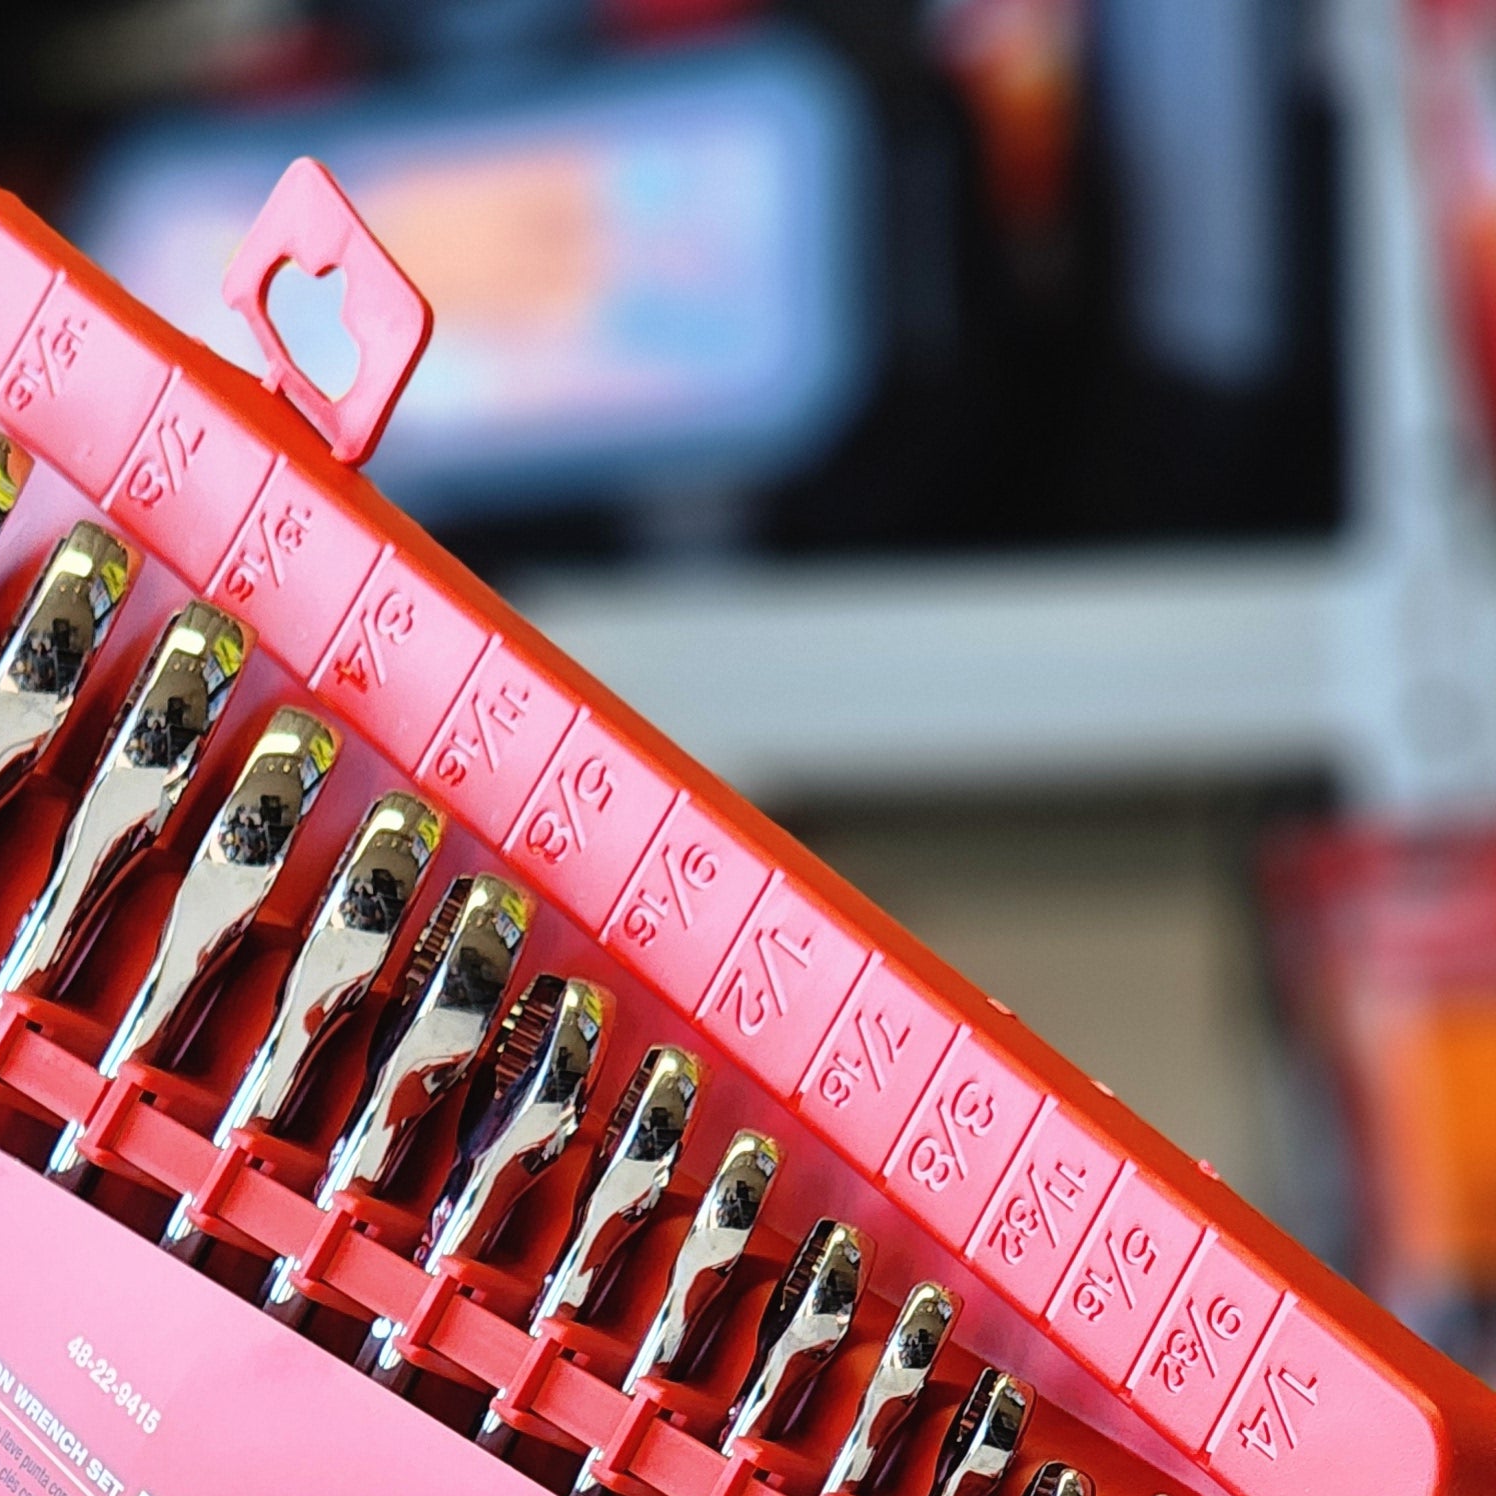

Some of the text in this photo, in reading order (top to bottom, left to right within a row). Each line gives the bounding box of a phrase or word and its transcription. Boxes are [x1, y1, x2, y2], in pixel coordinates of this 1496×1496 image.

[129, 414, 205, 509] 7/8
[332, 591, 415, 693] 3/4
[437, 680, 530, 786] 11/16
[524, 755, 617, 864] 5/8
[621, 840, 722, 949] 9/16
[715, 920, 814, 1037] 1/2
[817, 1009, 912, 1110] 7/16
[908, 1079, 996, 1195] 3/8
[988, 1157, 1087, 1267] 11/32
[1071, 1225, 1161, 1324] 5/16
[66, 1335, 162, 1435] 48-22-9415
[1150, 1293, 1245, 1395] 9/32
[0, 1429, 24, 1461] llave
[19, 1454, 50, 1489] punta
[13, 1383, 89, 1467] WRENCH
[1236, 1364, 1321, 1462] 1/4
